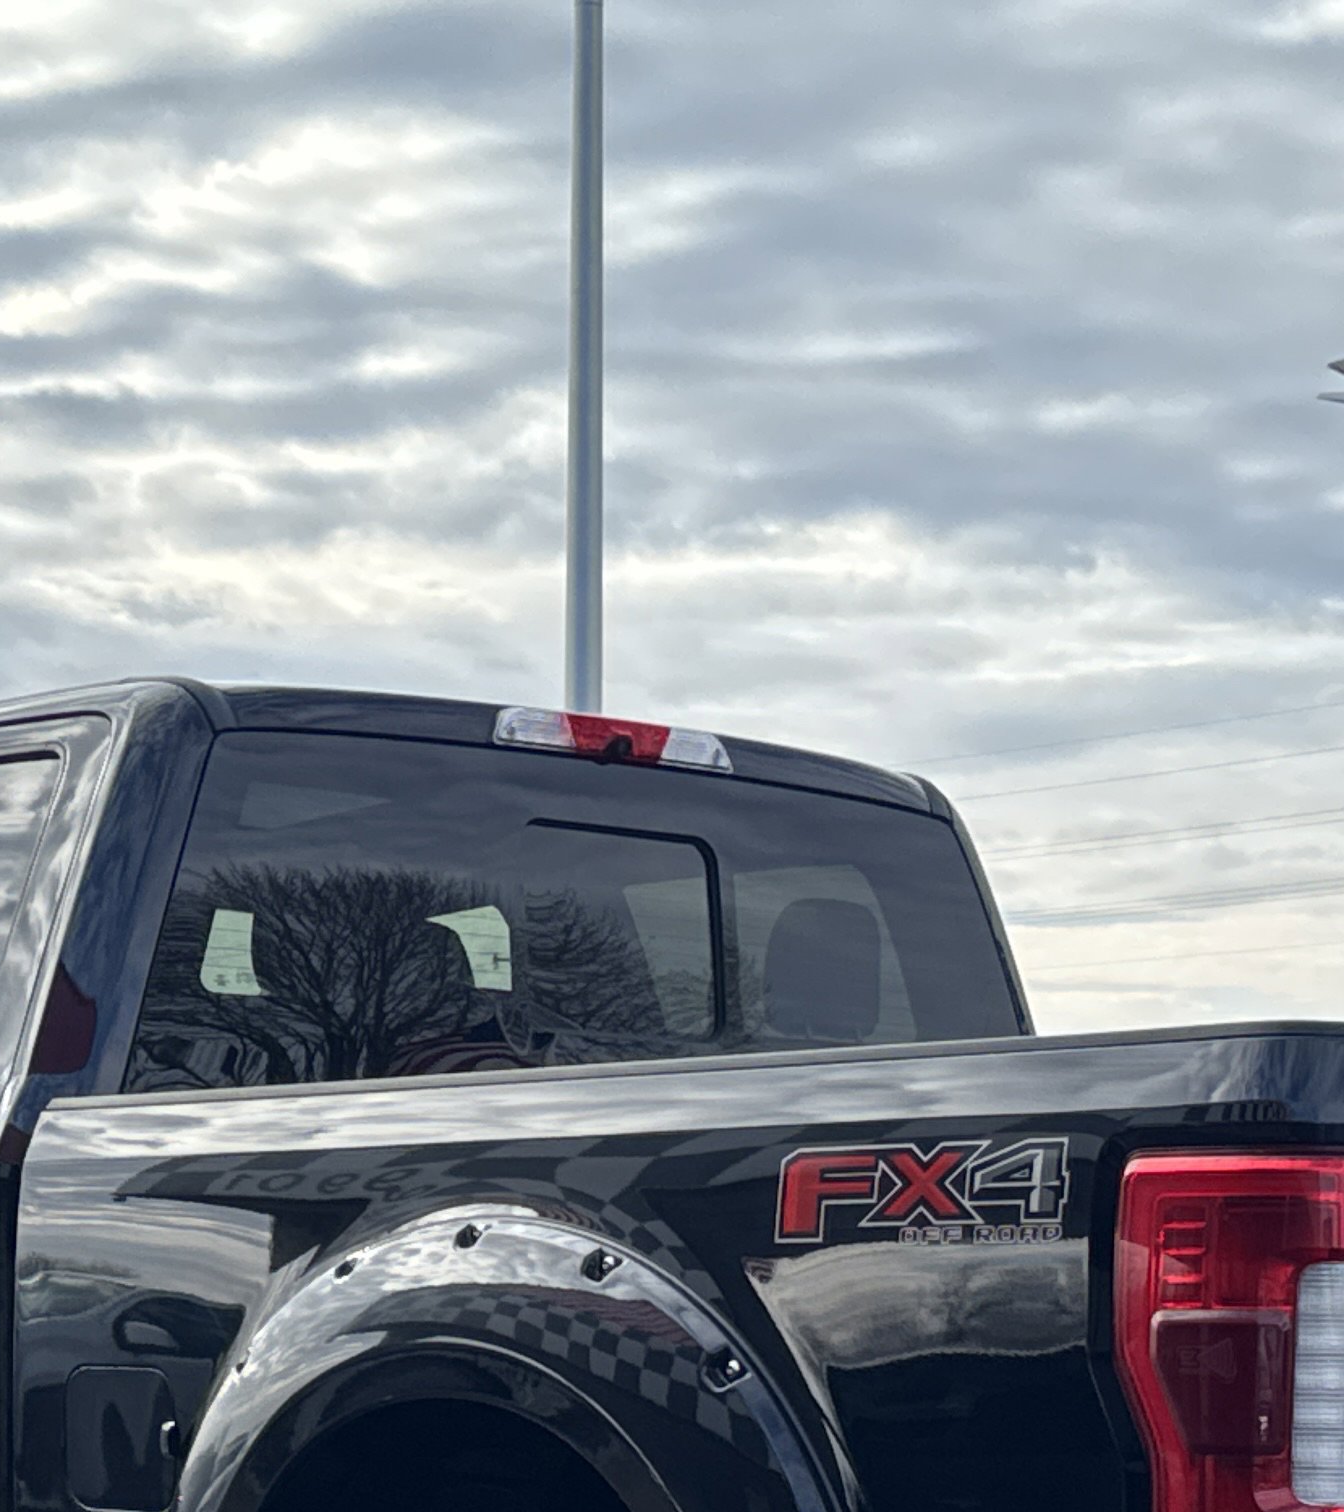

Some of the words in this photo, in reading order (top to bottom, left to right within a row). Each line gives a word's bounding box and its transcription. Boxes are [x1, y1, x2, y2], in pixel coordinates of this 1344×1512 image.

[775, 1137, 1069, 1243] FX4
[899, 1226, 963, 1246] OFF
[973, 1225, 1063, 1245] ROAD
